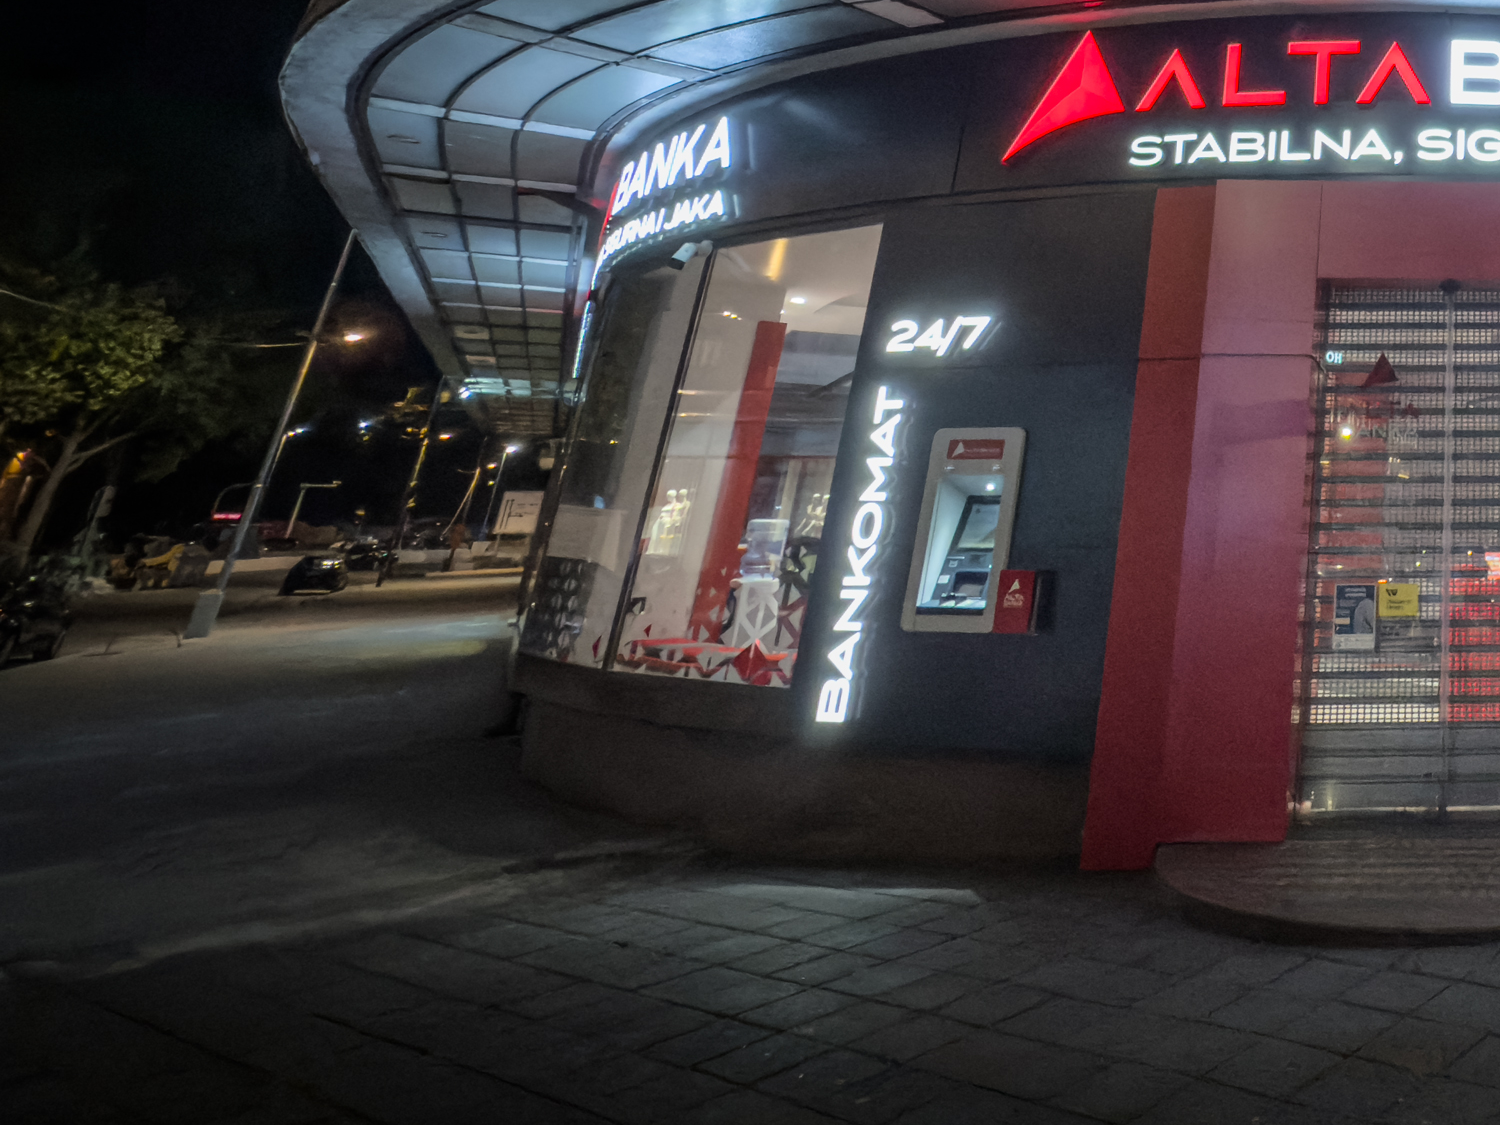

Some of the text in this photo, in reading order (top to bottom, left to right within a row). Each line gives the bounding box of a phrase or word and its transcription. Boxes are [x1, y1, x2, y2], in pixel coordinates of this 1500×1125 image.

[611, 116, 731, 216] BANKA
[1129, 128, 1404, 166] STABILNA,
[885, 315, 992, 358] 24/7
[814, 385, 905, 724] BANKOMAT
